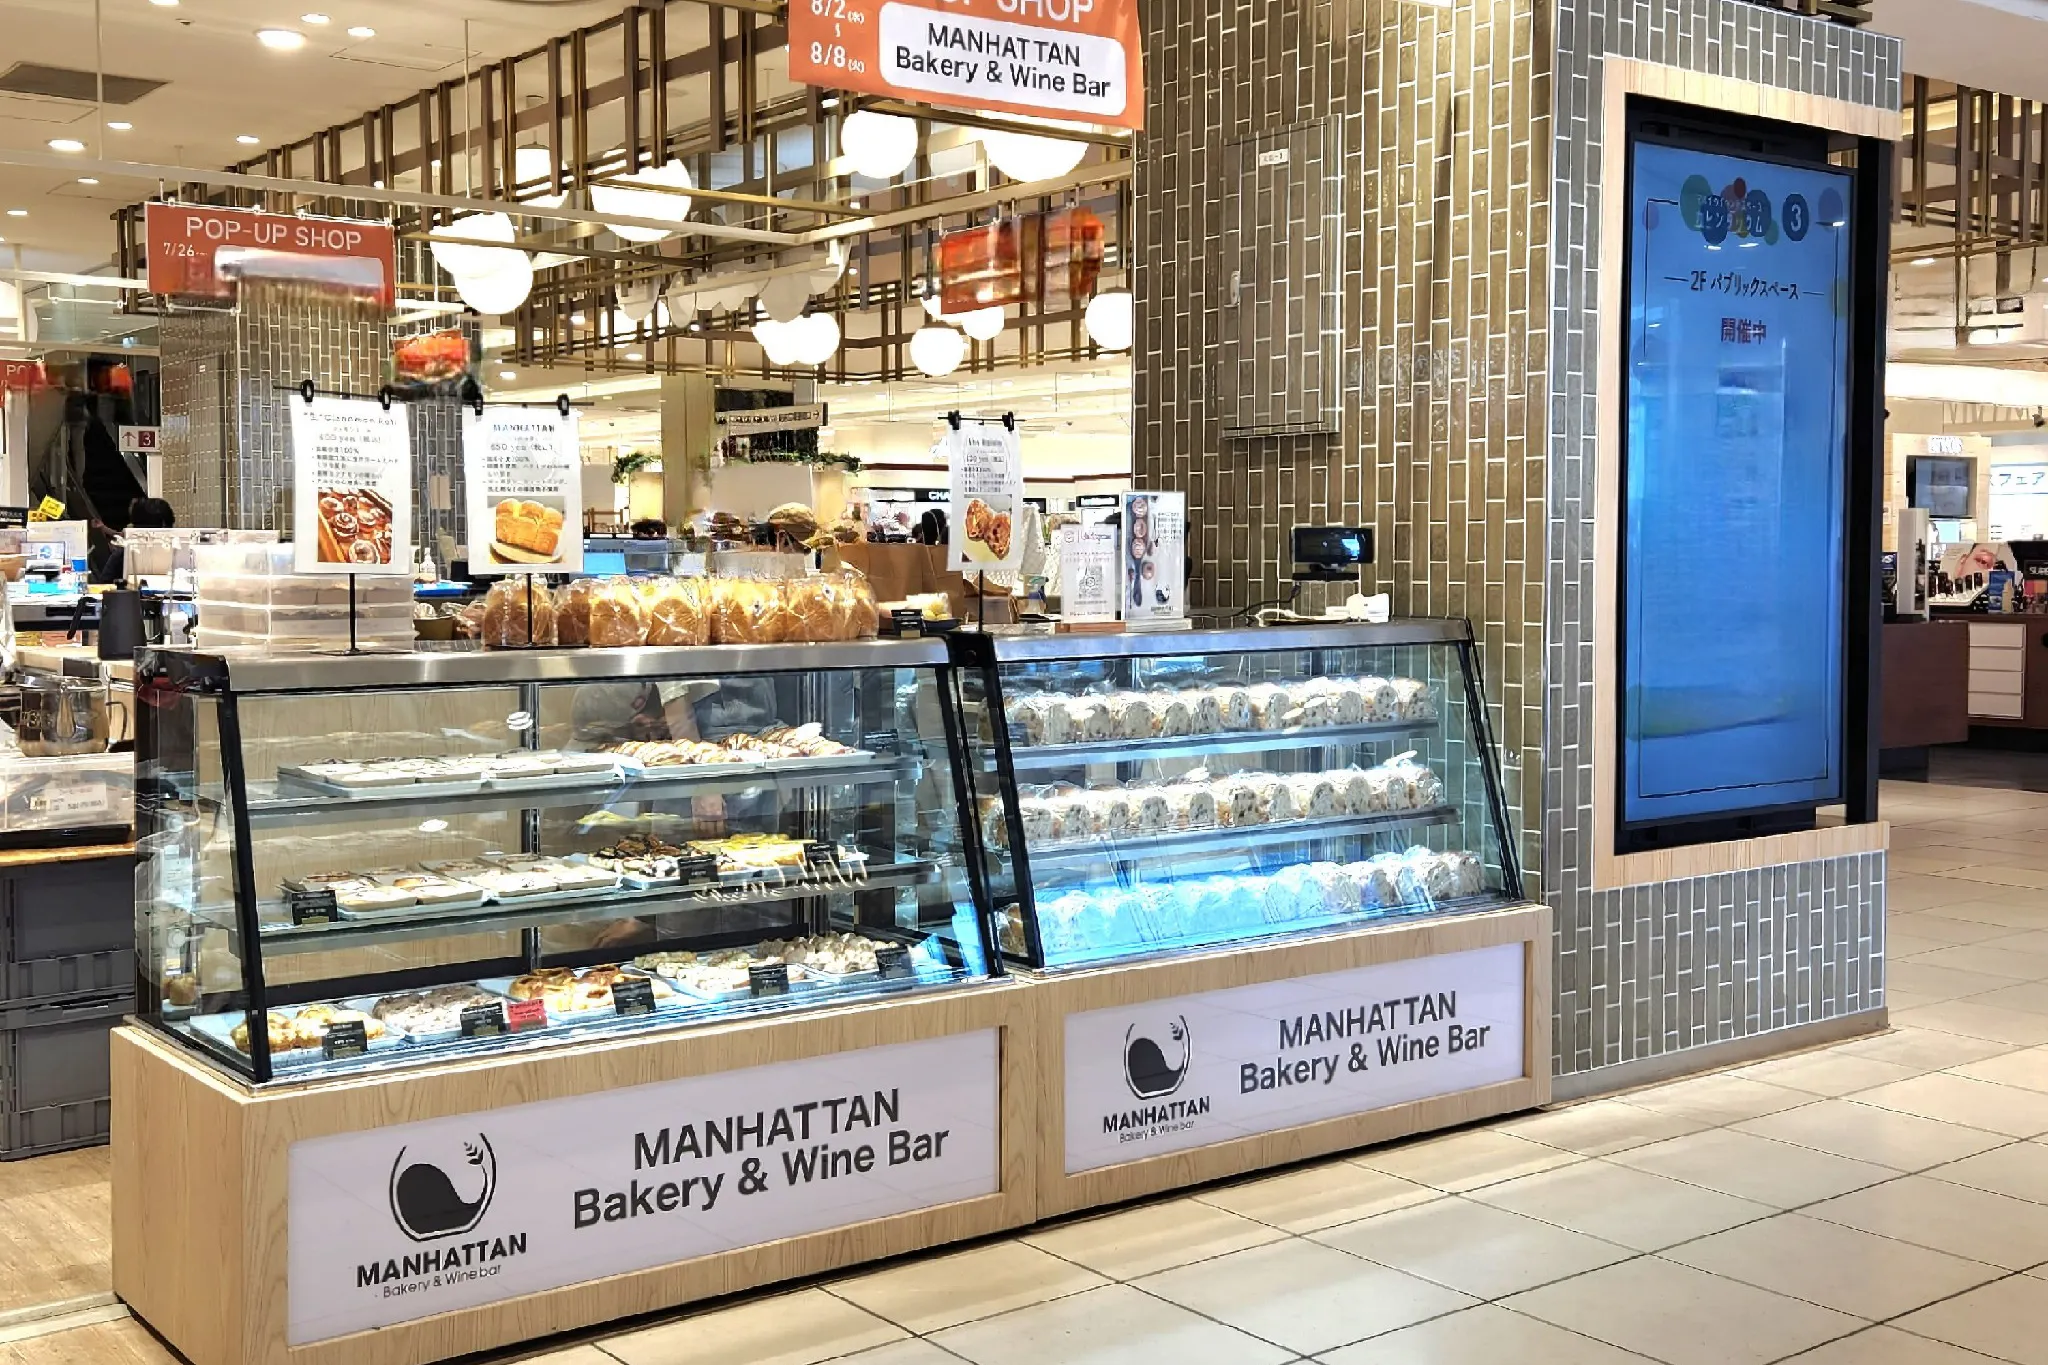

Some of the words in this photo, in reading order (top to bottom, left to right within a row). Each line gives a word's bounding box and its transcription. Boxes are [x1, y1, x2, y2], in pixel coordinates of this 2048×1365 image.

[928, 22, 1081, 67] MANHATTAN
[897, 45, 978, 83] Bakery
[986, 60, 1003, 83] &
[1010, 63, 1065, 92] Wine
[1072, 72, 1111, 98] Bar
[186, 216, 287, 244] POP-UP
[296, 226, 362, 250] SHOP
[1690, 270, 1707, 292] 2F
[1710, 271, 1799, 300] パブリックスペース
[1721, 317, 1767, 345] 開催中
[1279, 990, 1456, 1050] MANHATTAN
[1240, 1054, 1340, 1095] Bakery
[1347, 1043, 1369, 1073] &
[1376, 1033, 1440, 1067] Wine
[1448, 1024, 1491, 1054] Bar
[635, 1088, 899, 1171] MANHATTAN
[1103, 1095, 1210, 1134] MANHATTAN
[573, 1172, 726, 1230] Bakery
[737, 1157, 769, 1195] &
[782, 1143, 875, 1186] Wine
[888, 1129, 950, 1167] Bar
[356, 1232, 528, 1288] MANHATTAN
[383, 1279, 431, 1299] Bakery
[433, 1275, 442, 1287] &
[444, 1269, 478, 1285] Wine
[479, 1264, 502, 1278] bar
